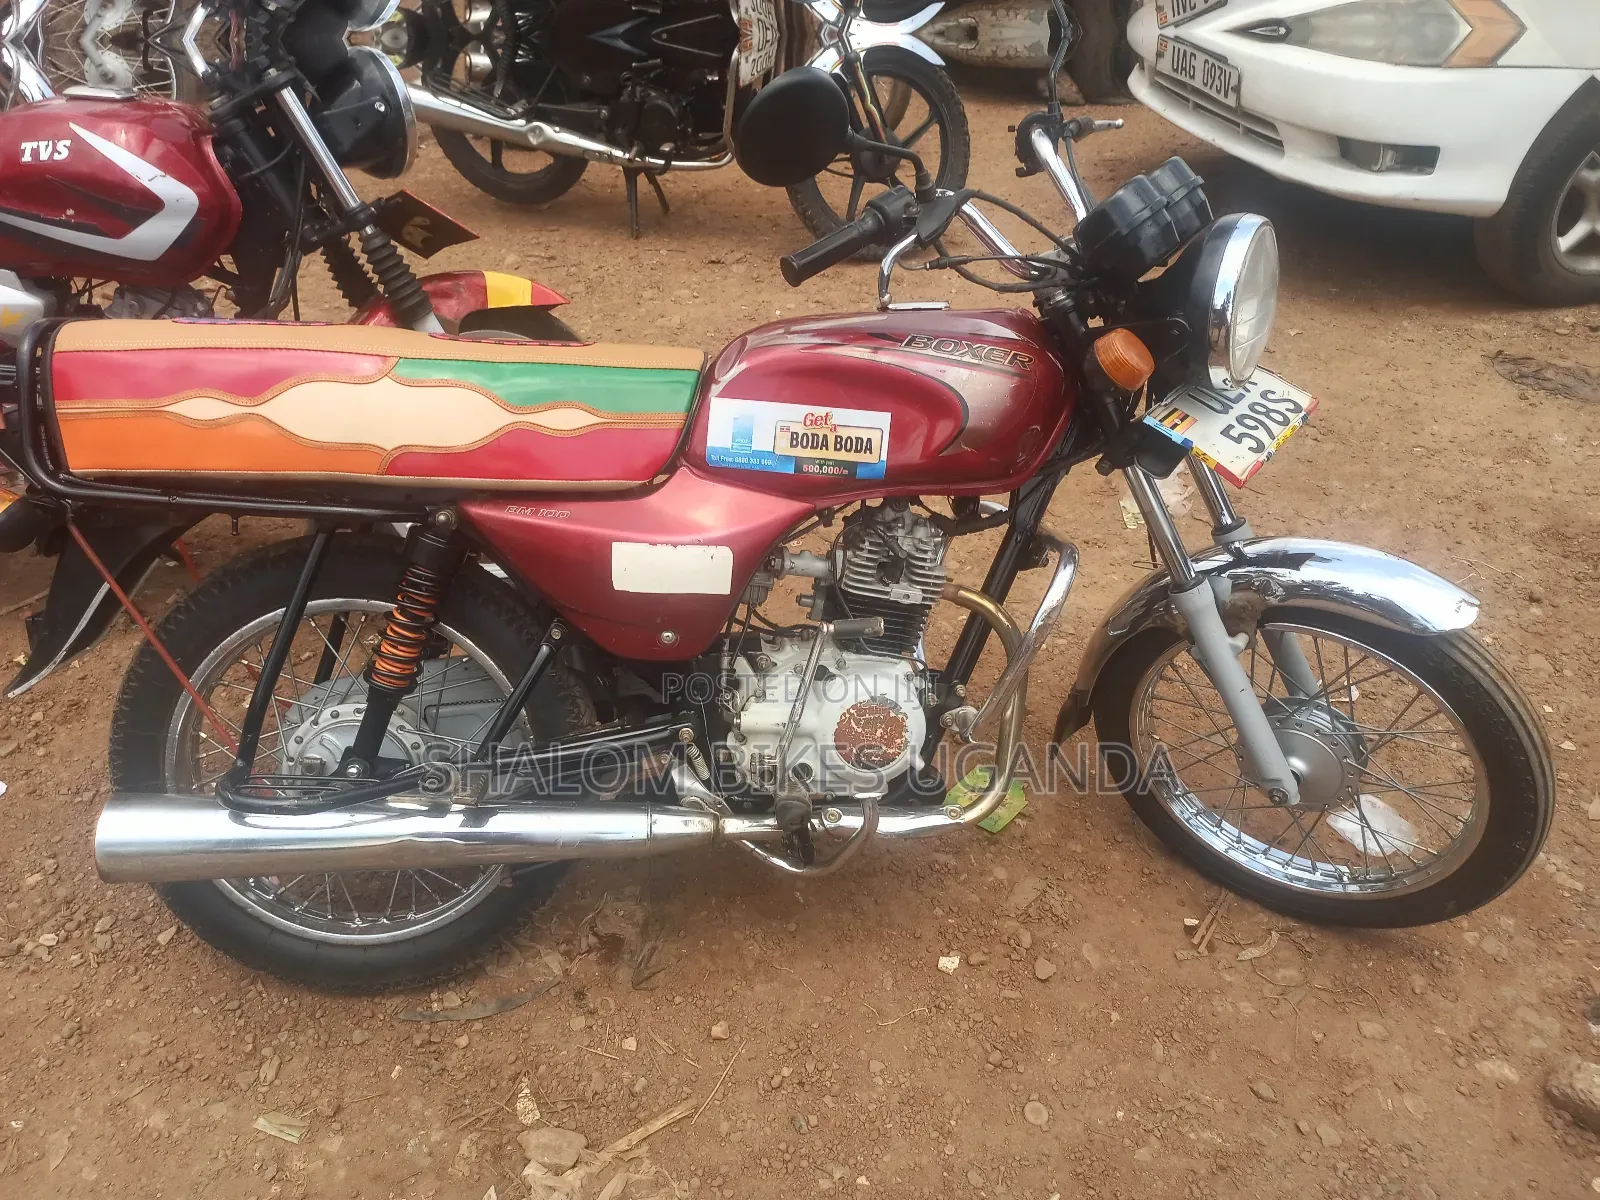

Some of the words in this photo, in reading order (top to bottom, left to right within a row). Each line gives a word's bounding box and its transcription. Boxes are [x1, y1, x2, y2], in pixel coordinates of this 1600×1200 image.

[1171, 45, 1197, 81] UAG
[1202, 59, 1232, 99] 093V
[20, 139, 72, 162] TVS
[899, 332, 1035, 371] BOXER
[803, 411, 833, 428] Get
[829, 423, 838, 433] a
[1220, 389, 1303, 454] 598S
[789, 431, 829, 451] BODA
[833, 434, 873, 454] BODA
[505, 505, 535, 516] BM
[537, 508, 571, 518] 100
